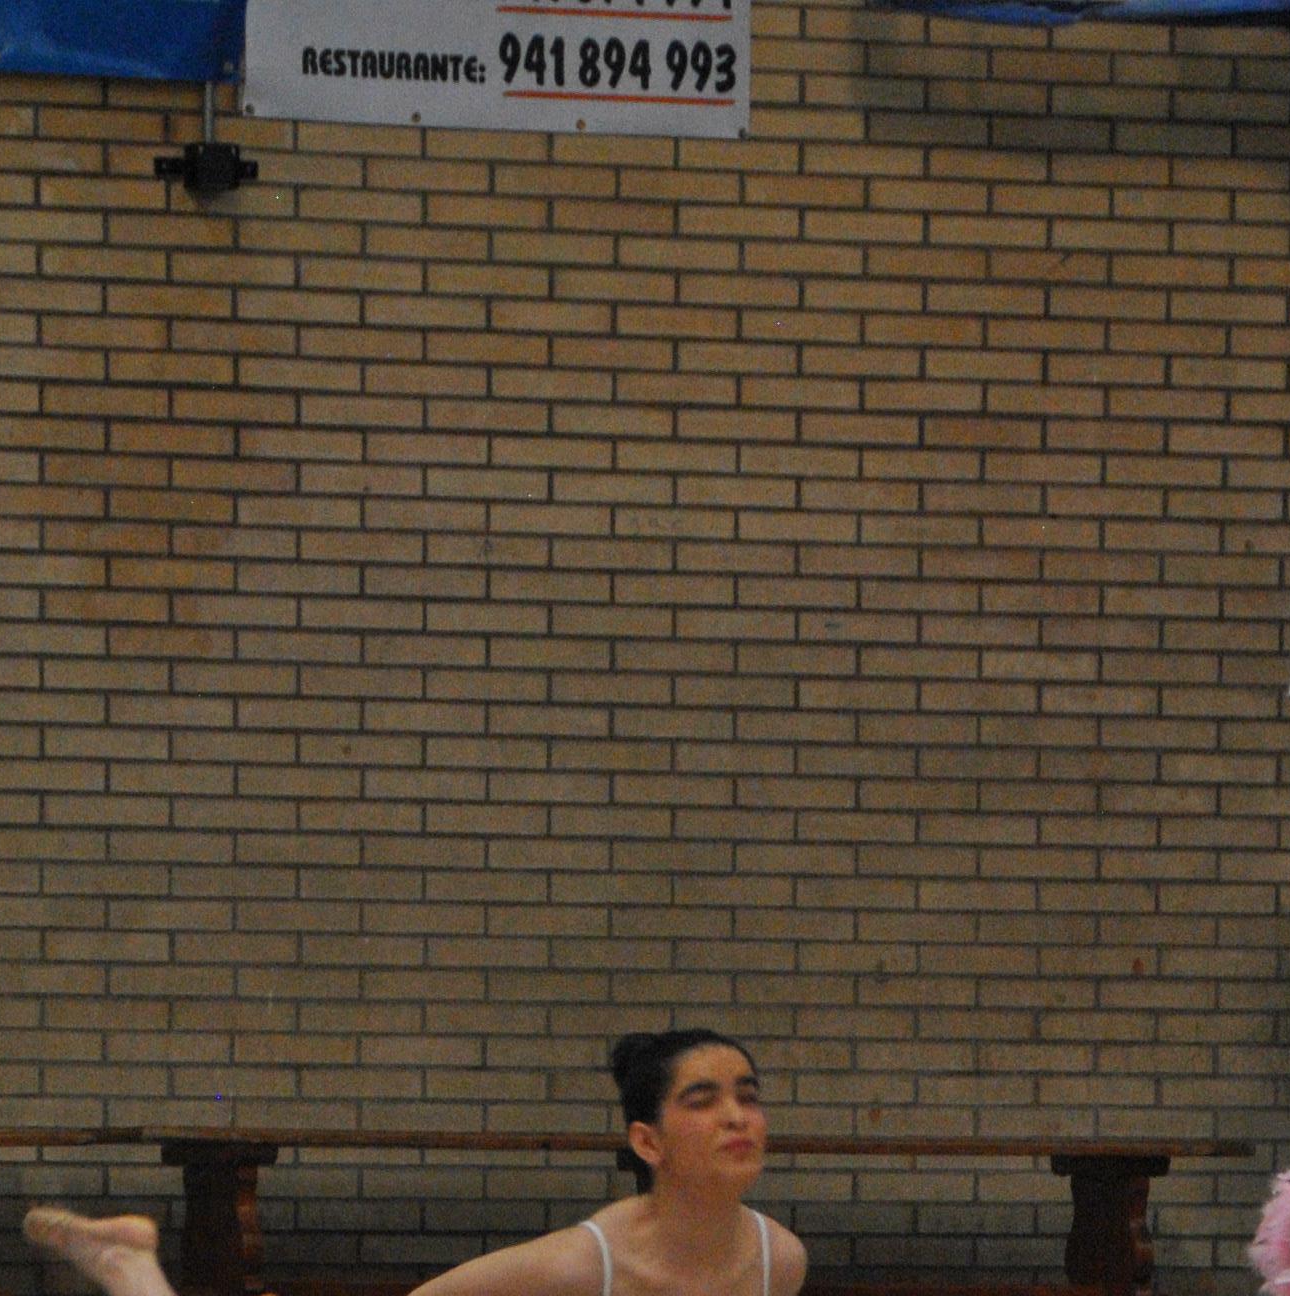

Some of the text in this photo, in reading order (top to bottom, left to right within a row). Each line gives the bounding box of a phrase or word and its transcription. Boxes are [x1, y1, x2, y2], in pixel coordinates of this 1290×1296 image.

[302, 32, 737, 93] RESTAURANTE: 941 894 993
